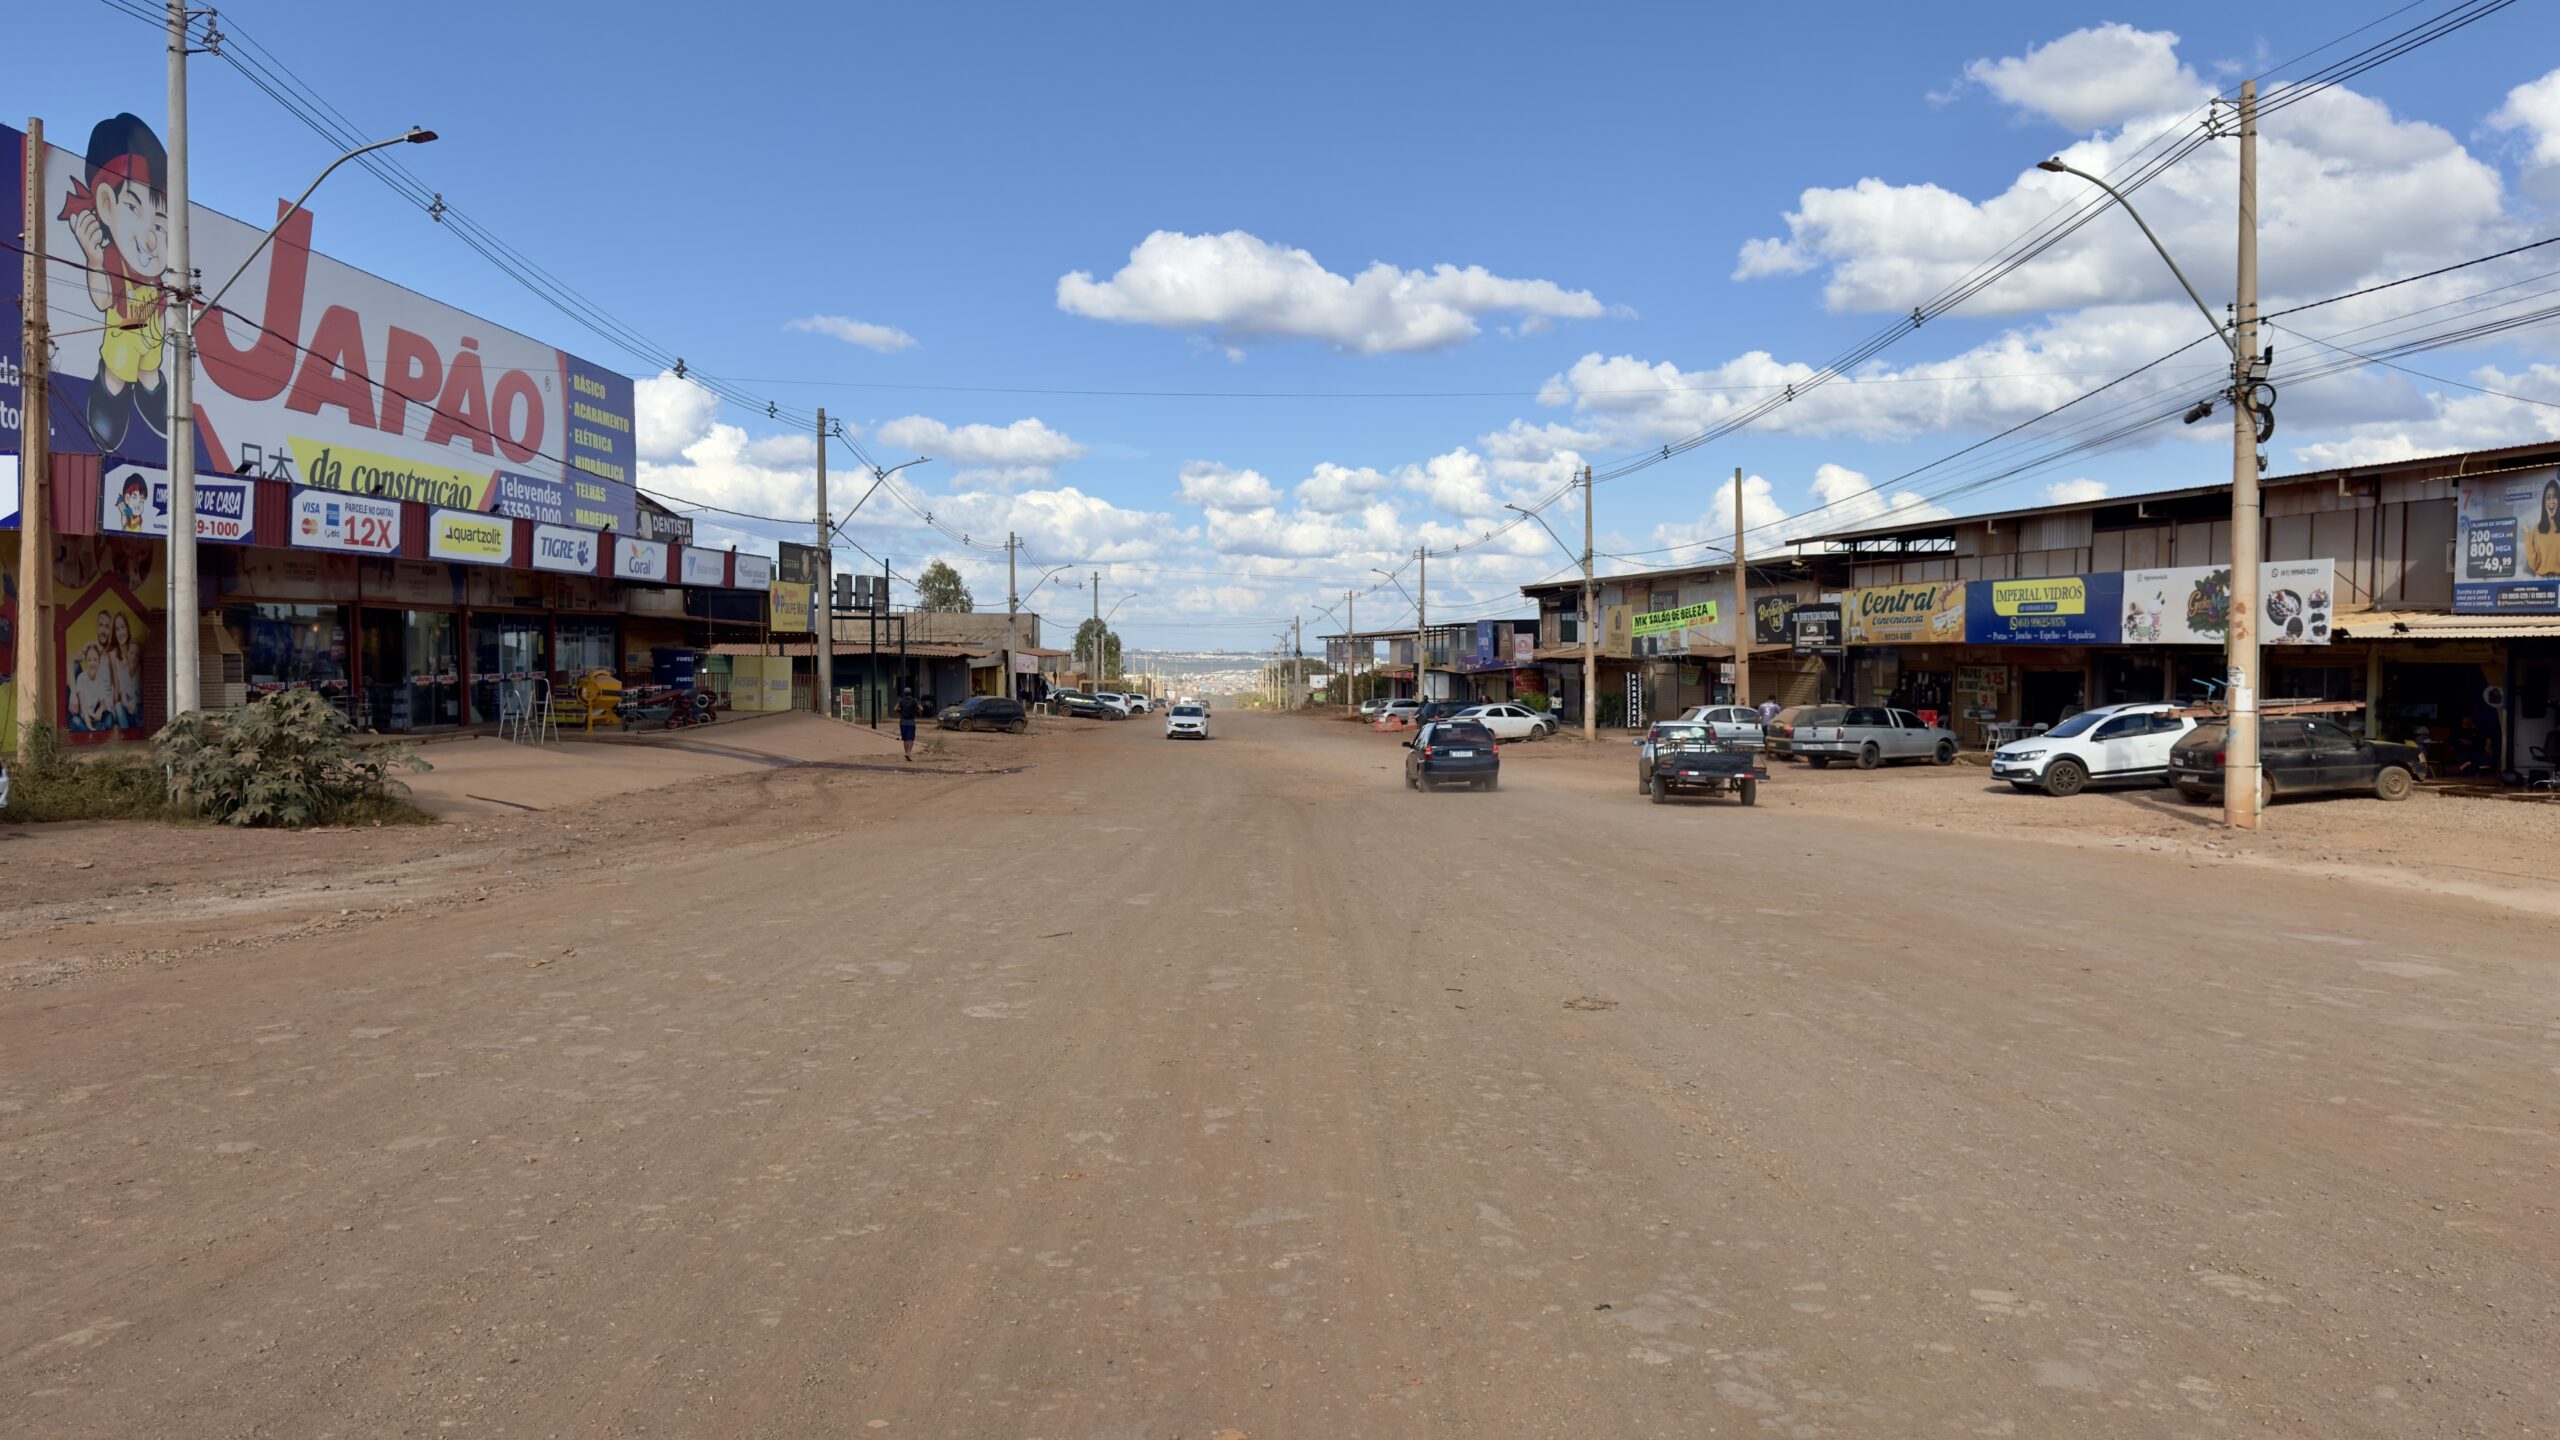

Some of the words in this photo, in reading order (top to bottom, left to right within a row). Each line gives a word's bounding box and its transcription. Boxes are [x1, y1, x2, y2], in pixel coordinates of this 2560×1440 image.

[190, 198, 546, 463] JAPÃO
[574, 374, 606, 399] BÁSICO
[574, 402, 629, 433] ACABAMENTO
[574, 428, 613, 454] ELÉTRICA
[308, 447, 343, 490] da
[574, 455, 625, 482] HIDRÁULICA
[204, 491, 215, 511] DE
[216, 491, 241, 515] CASA
[500, 476, 562, 506] Televendas
[575, 482, 606, 502] TELHAS
[302, 502, 320, 514] VISA
[344, 502, 368, 515] PARCELE
[368, 506, 376, 515] NO
[376, 507, 394, 518] CARTÃO
[501, 500, 562, 524] 3359-1000
[575, 509, 619, 530] MADEIRAS
[344, 515, 393, 549] 12X
[453, 527, 502, 546] quartzolit
[652, 515, 692, 536] DENTISTA
[2470, 530, 2491, 544] 200
[540, 536, 575, 560] TIGRE
[2470, 542, 2494, 558] 800
[628, 556, 651, 575] Coral
[1862, 586, 1937, 617] Central
[1995, 588, 2042, 603] IMPERIAL
[2043, 585, 2083, 600] VIDROS
[1634, 616, 1648, 628] MK
[1680, 603, 1709, 621] BELEZA
